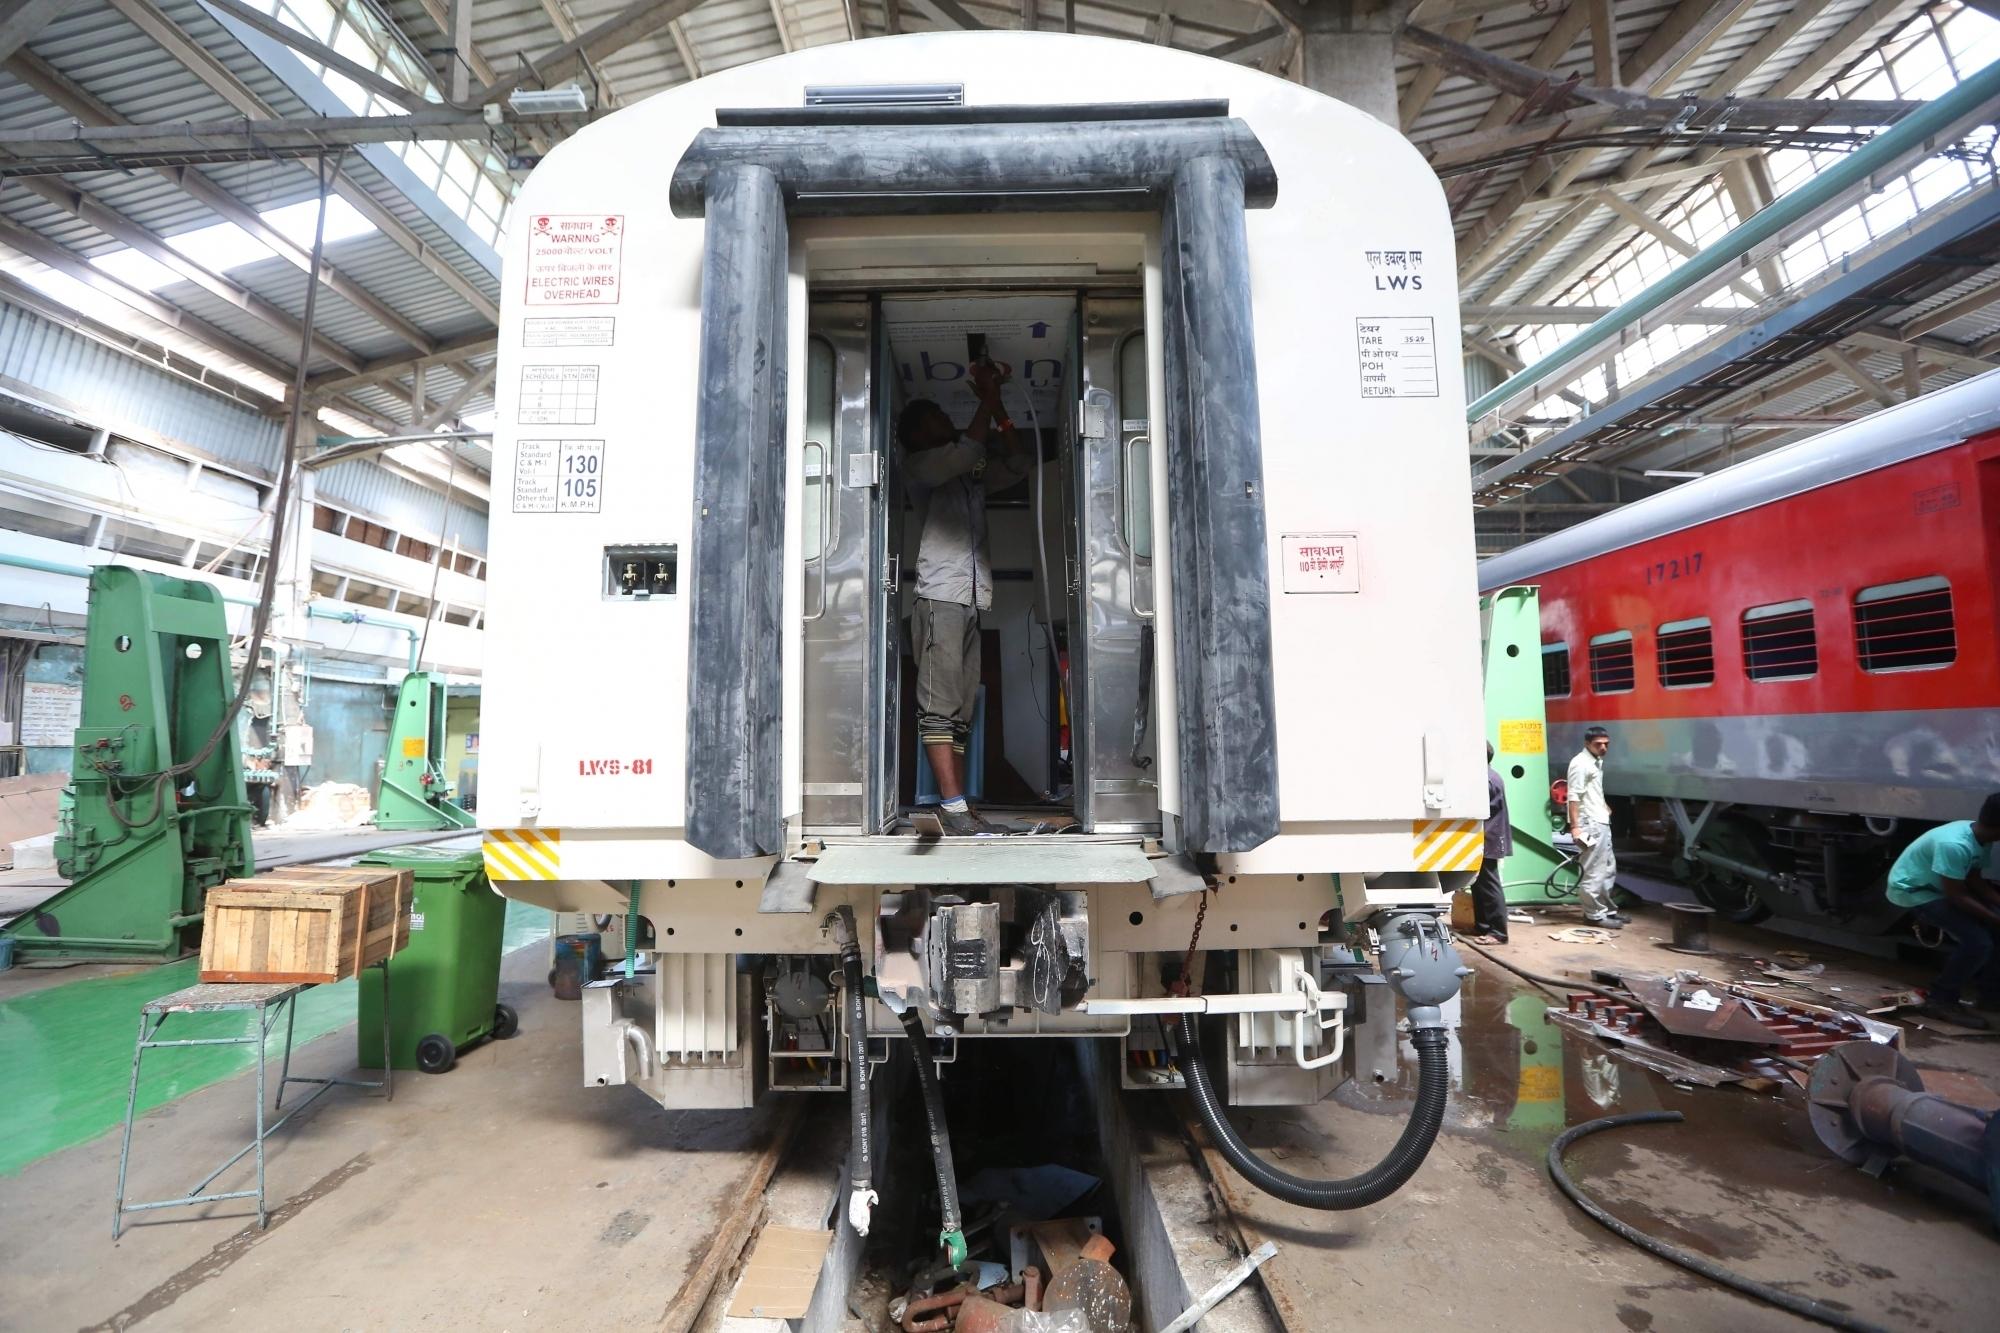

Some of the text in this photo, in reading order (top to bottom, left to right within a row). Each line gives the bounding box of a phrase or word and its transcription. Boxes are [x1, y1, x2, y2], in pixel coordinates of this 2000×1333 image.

[551, 234, 600, 243] WARNING
[536, 248, 562, 256] 25000
[532, 276, 615, 287] ELECTRIC WIRES
[1375, 275, 1423, 291] LWS
[544, 289, 600, 300] OVERHEAD
[1360, 336, 1383, 345] TARE
[1362, 362, 1384, 370] POH
[1363, 386, 1396, 395] RETURN
[521, 442, 540, 450] Track
[566, 454, 598, 474] 130
[516, 486, 548, 494] Standard
[564, 478, 597, 498] 105
[516, 494, 537, 502] Other
[1299, 546, 1344, 557] सावधान
[1300, 562, 1310, 572] 110
[1646, 552, 1703, 585] 17217
[580, 758, 652, 776] LWS-81
[944, 1196, 952, 1210] BONY
